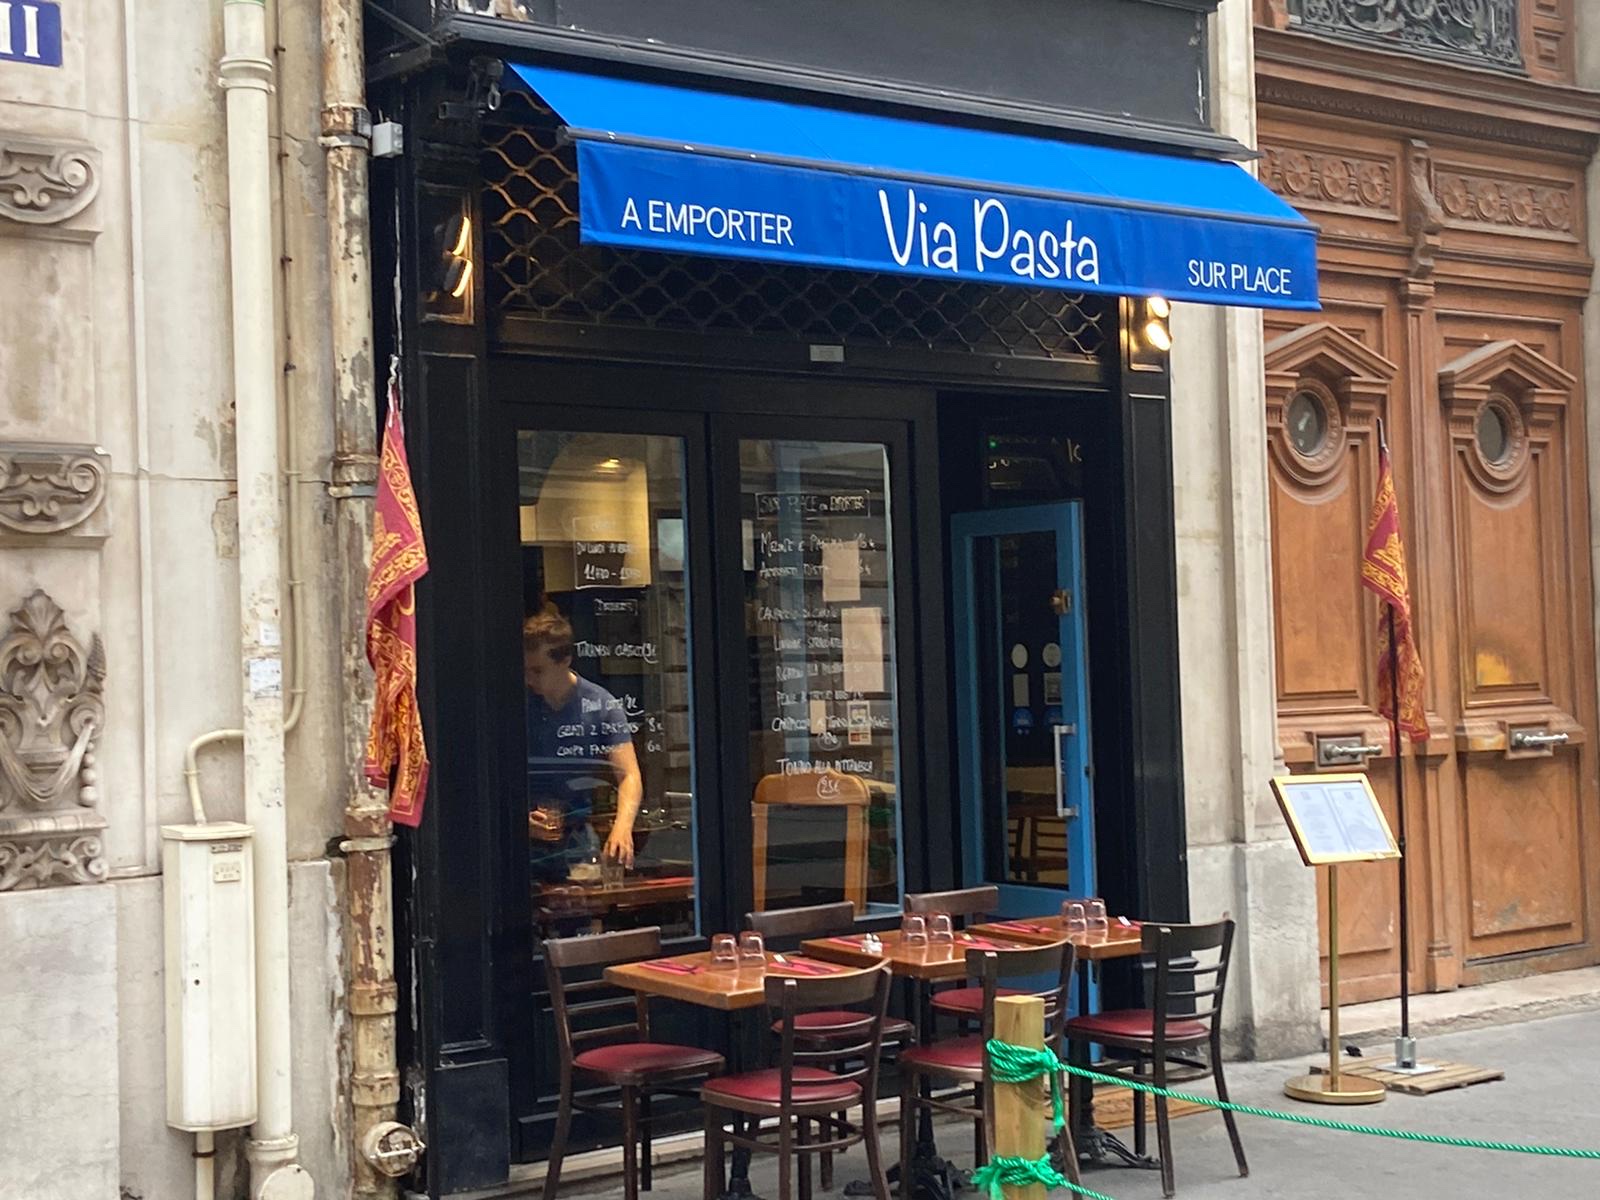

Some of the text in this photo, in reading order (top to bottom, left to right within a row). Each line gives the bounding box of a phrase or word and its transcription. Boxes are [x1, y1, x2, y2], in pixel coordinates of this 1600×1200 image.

[621, 198, 793, 246] A EMPORTER
[879, 188, 1099, 285] Via Pasta
[1188, 259, 1292, 295] SUR PLACE
